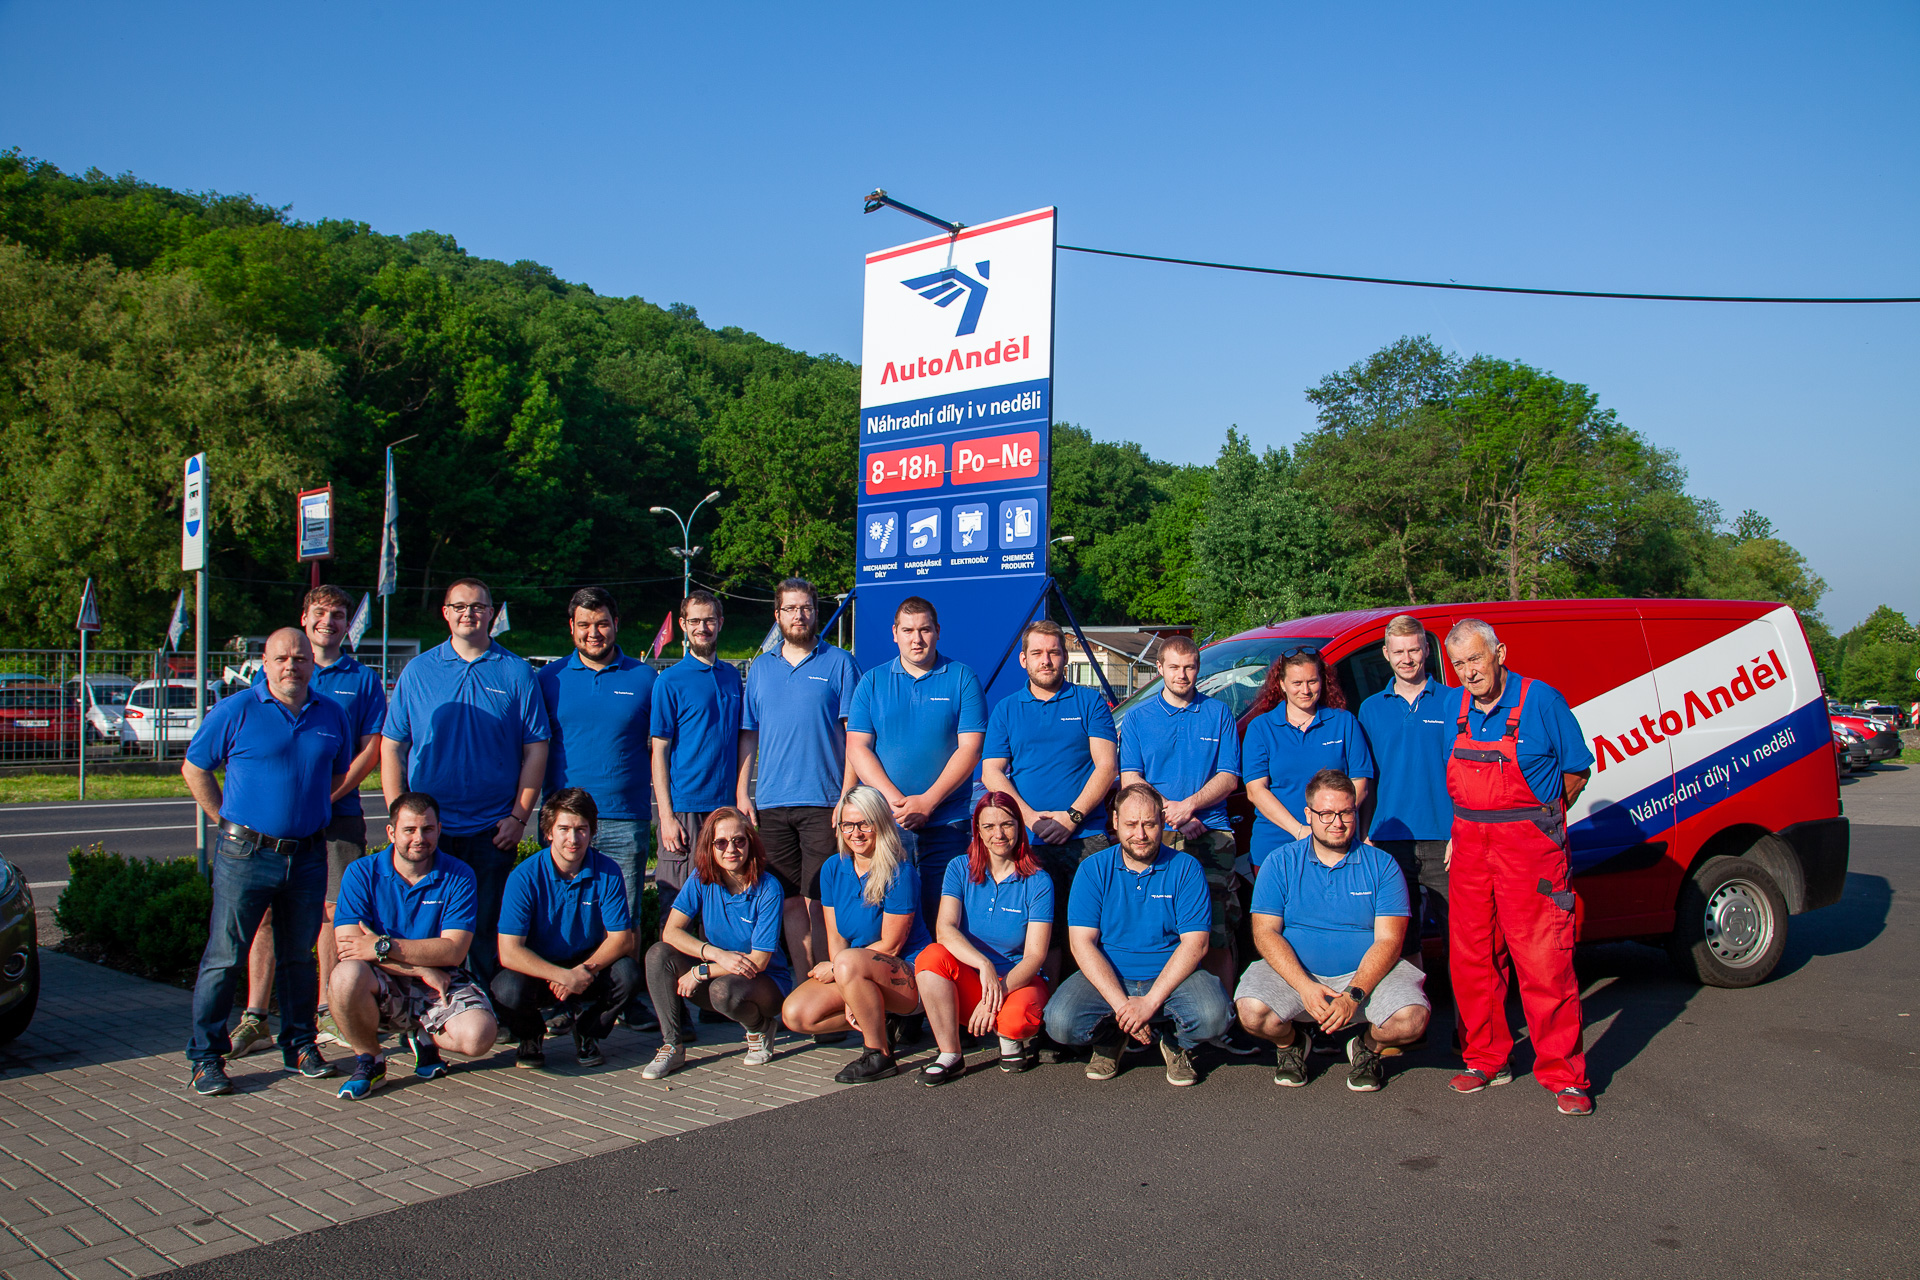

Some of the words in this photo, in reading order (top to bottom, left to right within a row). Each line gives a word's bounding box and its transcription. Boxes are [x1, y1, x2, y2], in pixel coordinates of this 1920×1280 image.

[881, 335, 1030, 385] AutoAnděl
[867, 407, 934, 434] Náhradní
[936, 403, 964, 425] díly
[967, 401, 973, 419] i
[976, 403, 987, 417] v
[990, 390, 1042, 416] neděli
[950, 555, 989, 565] ELEKTRODÍLY
[1002, 552, 1034, 562] CHEMICKÉ
[863, 562, 898, 571] MECHANICKÉ
[904, 558, 942, 569] KAROSÁŘSKÉ
[1001, 561, 1035, 570] PRODUKTY
[874, 570, 887, 579] DÍLY
[916, 566, 930, 576] DÍLY
[1592, 648, 1788, 774] AutoAnděl
[1629, 776, 1702, 825] Náhradní
[1703, 762, 1730, 788] díly
[1731, 756, 1740, 773] i
[1740, 754, 1750, 768] v
[1752, 726, 1796, 763] neděli
